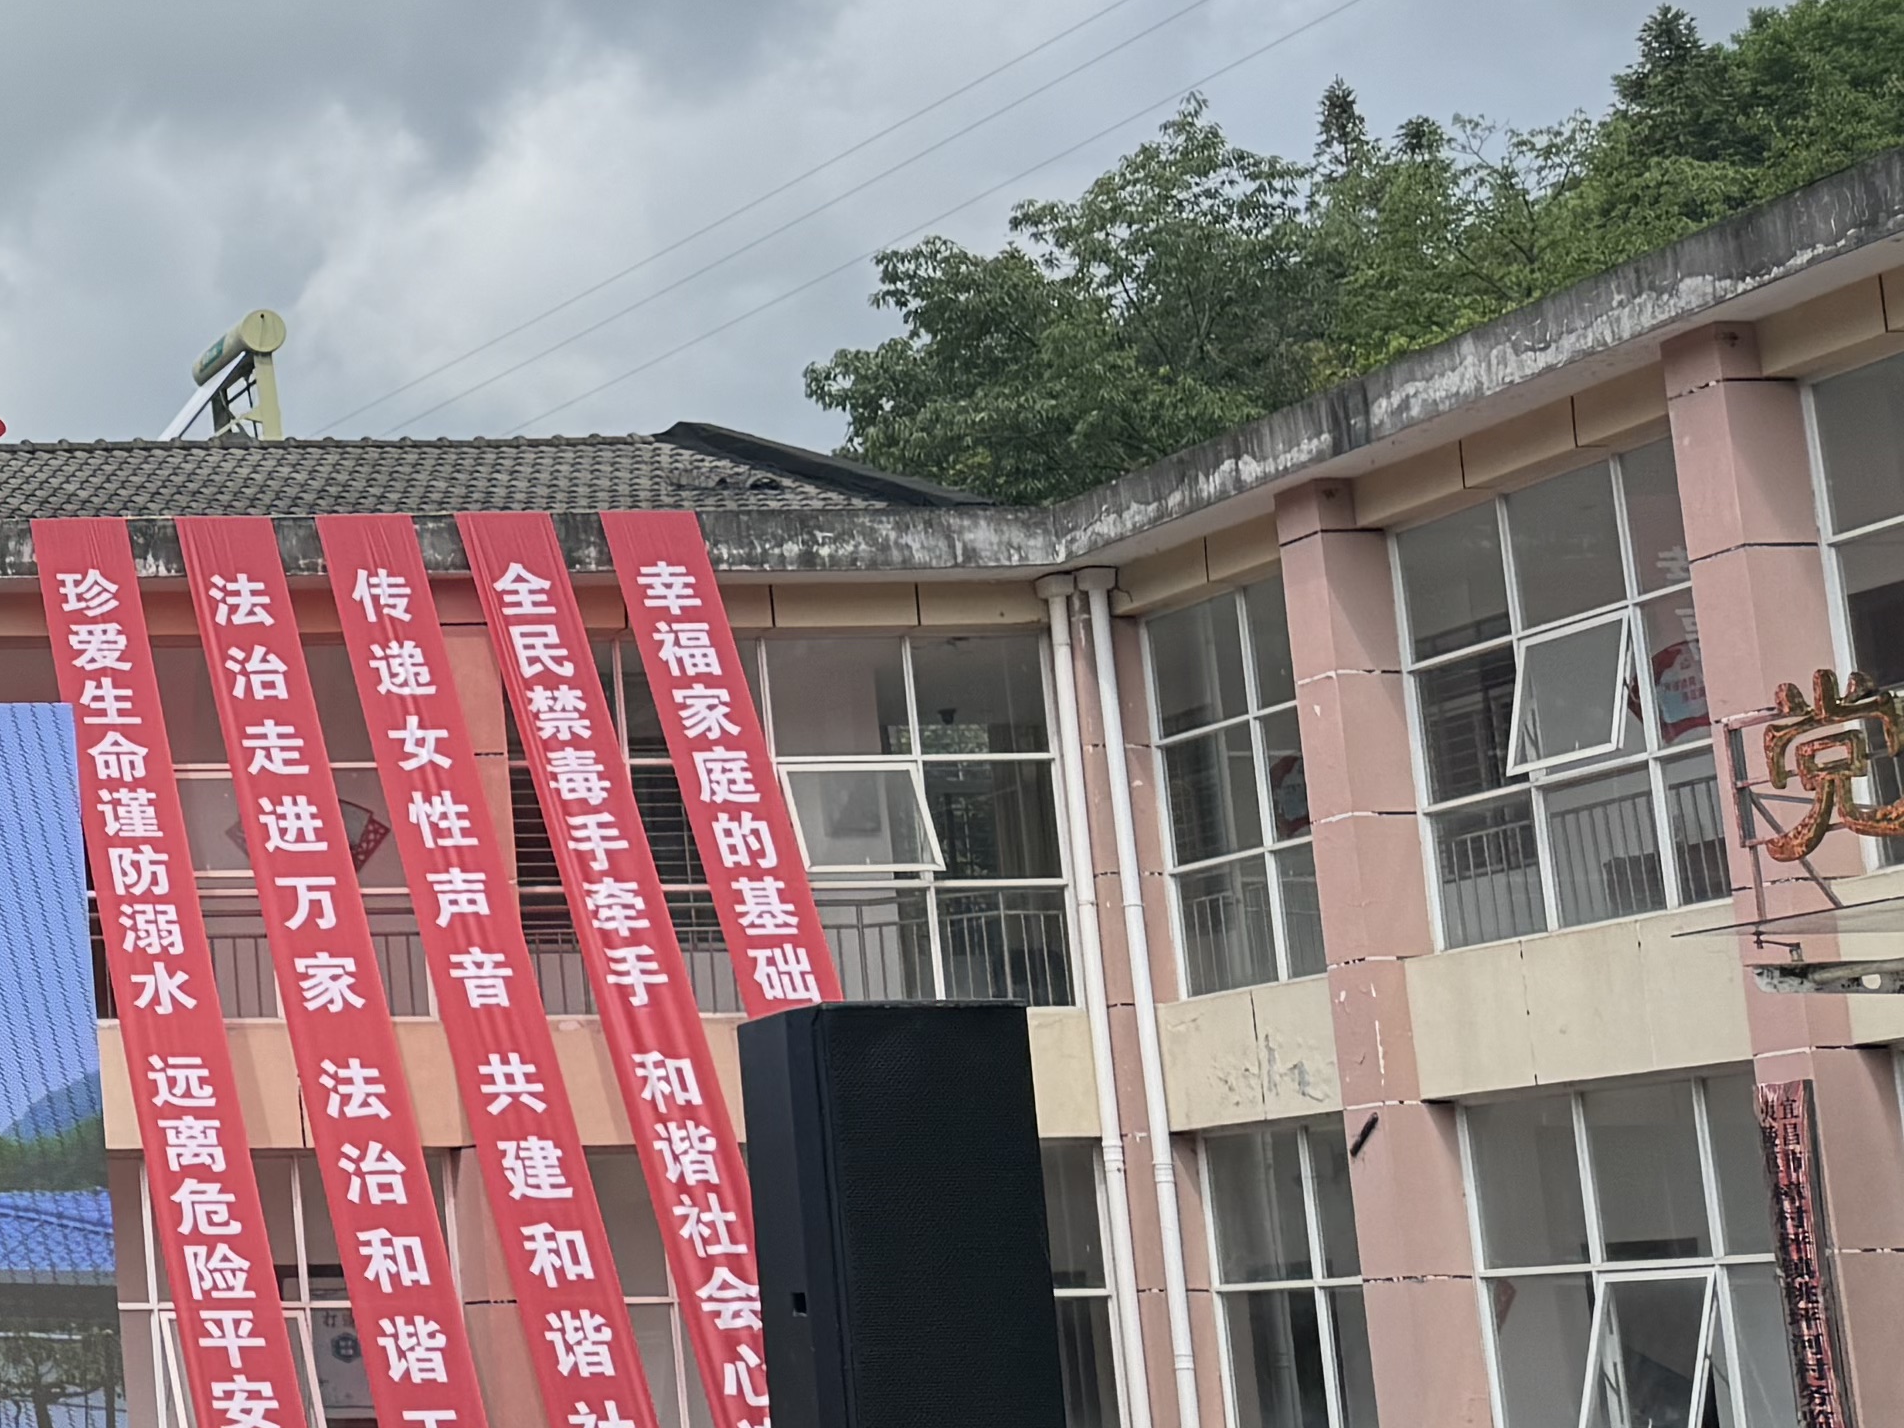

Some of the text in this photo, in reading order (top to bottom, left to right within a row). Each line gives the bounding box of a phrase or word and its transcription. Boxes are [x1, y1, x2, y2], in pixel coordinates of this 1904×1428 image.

[56, 568, 197, 1015] 珍爱生命谨防溺水
[208, 573, 366, 1013] 法治走进万家
[352, 568, 512, 1009] 传递女性声音
[493, 562, 669, 1007] 全民禁毒手牵手
[637, 560, 823, 1003] 幸福家庭的基础
